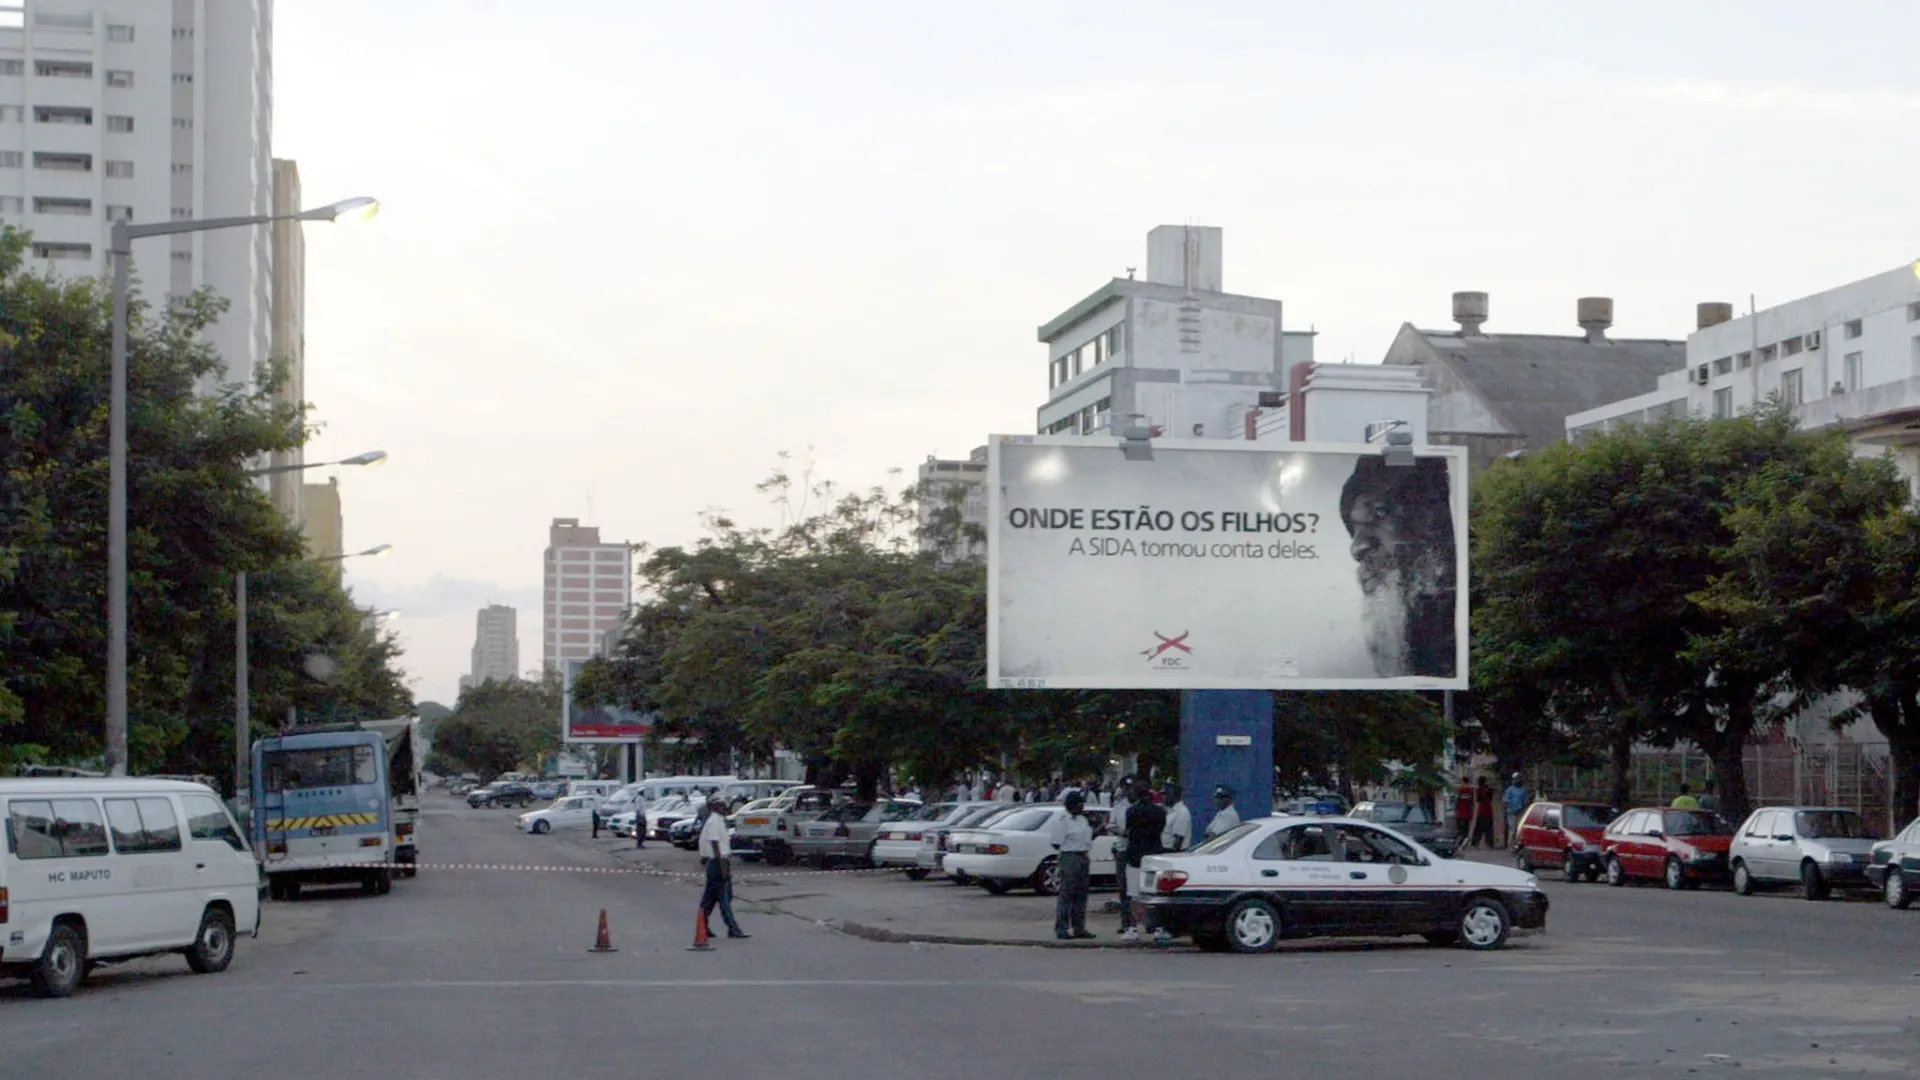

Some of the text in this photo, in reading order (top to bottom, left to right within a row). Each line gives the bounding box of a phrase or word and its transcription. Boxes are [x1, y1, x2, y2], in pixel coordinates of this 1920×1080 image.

[1009, 506, 1319, 534] ONDE ESTÃO OS FILHOS?
[1068, 538, 1320, 559] A SIDA tomou conta deles.
[1162, 657, 1181, 666] FDC
[48, 869, 111, 883] HC MAPUTO
